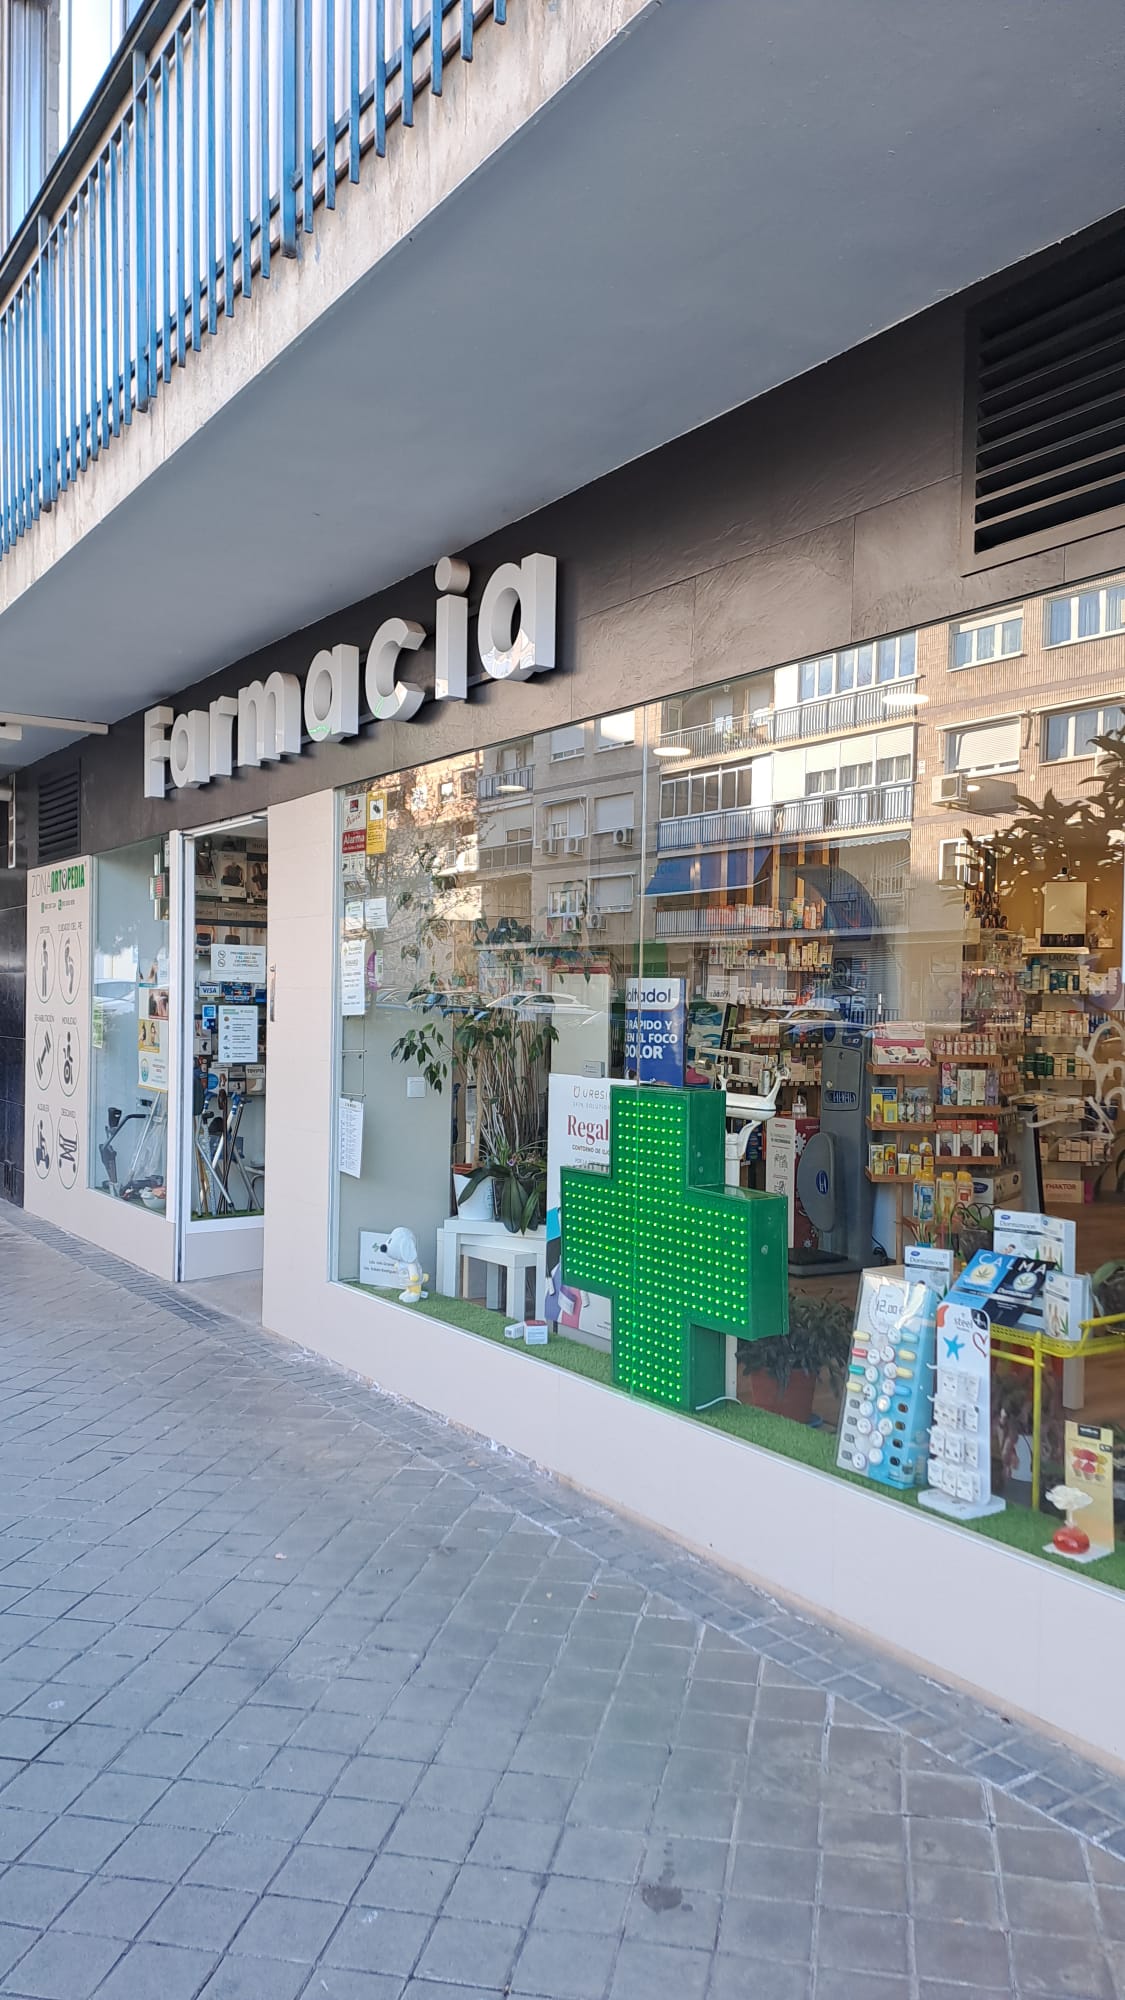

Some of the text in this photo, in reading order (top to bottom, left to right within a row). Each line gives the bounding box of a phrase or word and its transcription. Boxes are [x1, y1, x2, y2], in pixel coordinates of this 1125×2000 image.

[144, 552, 558, 799] Farmacia
[343, 834, 365, 845] Alarma
[50, 863, 85, 894] ORTOPEDIA
[625, 988, 671, 1003] oltadol
[629, 1017, 673, 1031] RÁPIDO Y
[627, 1033, 635, 1042] EN
[648, 1033, 678, 1044] FOCO
[567, 1114, 609, 1146] Regal
[978, 1253, 1047, 1276] CALMA
[953, 1316, 973, 1329] steel
